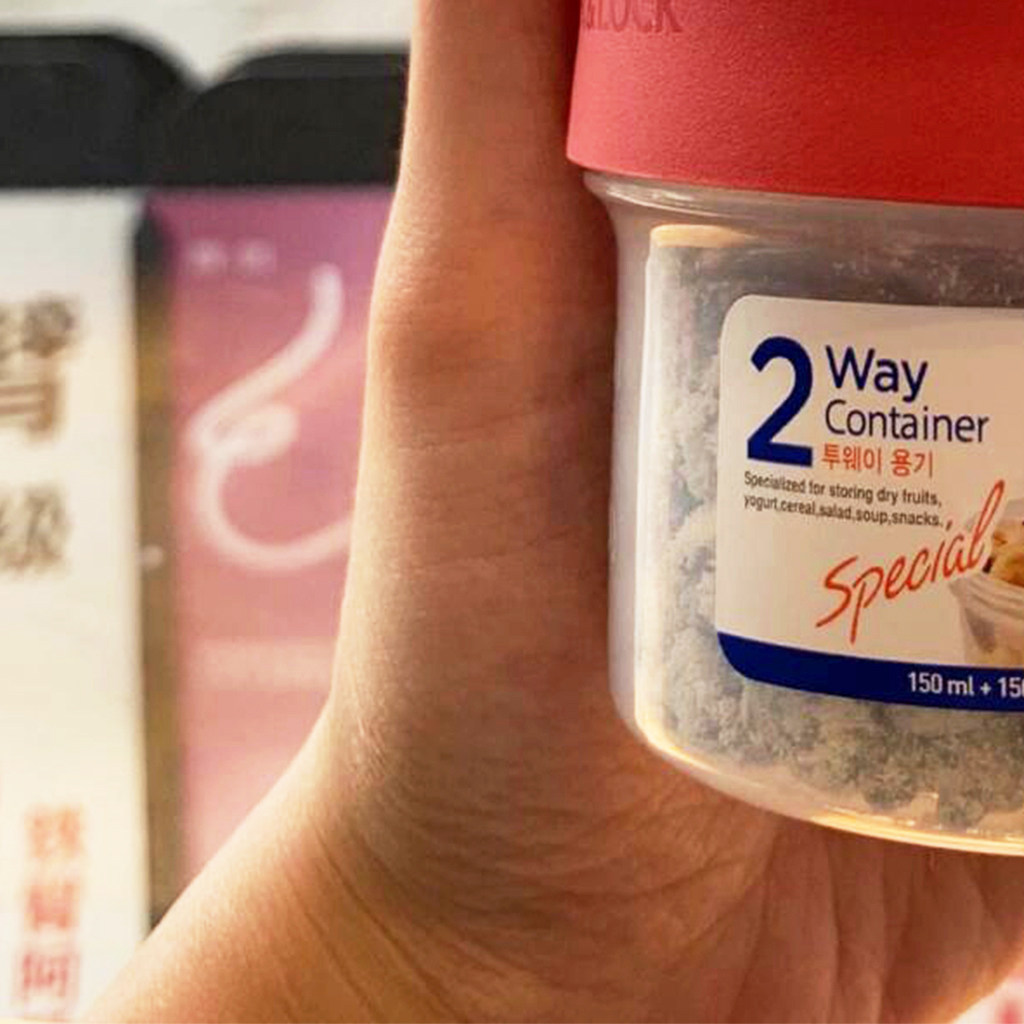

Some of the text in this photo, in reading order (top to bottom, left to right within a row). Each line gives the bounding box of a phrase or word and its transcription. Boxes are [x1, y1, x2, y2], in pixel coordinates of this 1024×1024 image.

[825, 344, 928, 403] Way
[747, 336, 813, 467] 2
[825, 399, 989, 443] Container
[821, 443, 934, 478] 투웨이 용기
[744, 471, 942, 508] Specialized for storing dry fruits,
[816, 479, 1005, 645] Special
[908, 673, 943, 693] 150
[947, 676, 974, 696] ml
[980, 682, 992, 695] +
